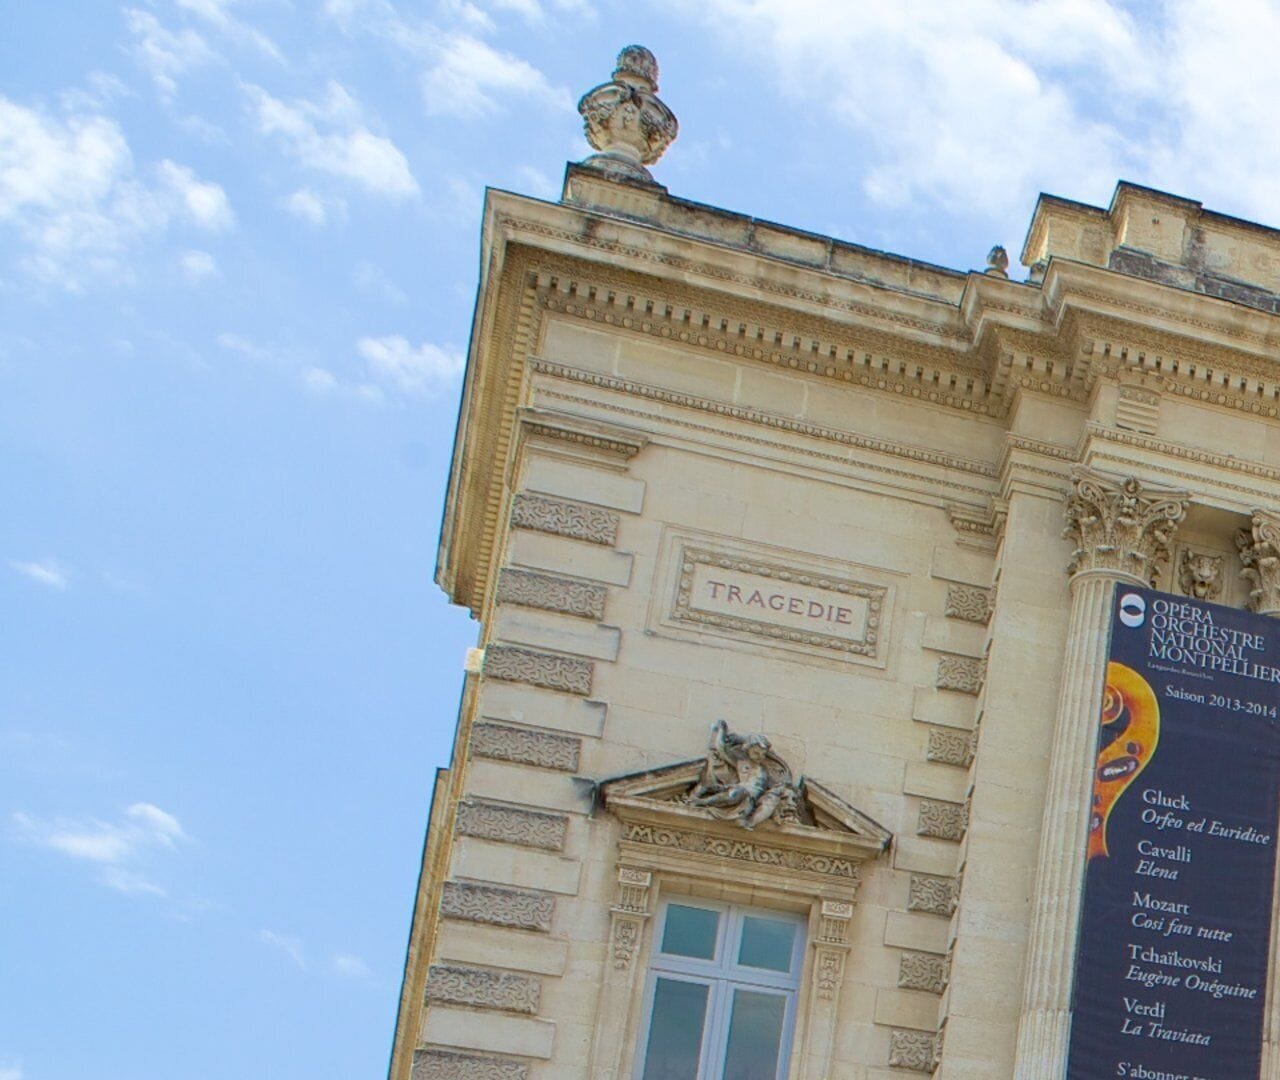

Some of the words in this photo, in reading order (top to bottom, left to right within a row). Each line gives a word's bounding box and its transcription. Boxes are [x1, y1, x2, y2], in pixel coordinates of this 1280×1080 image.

[707, 580, 853, 624] TRAGEDIE
[1153, 600, 1214, 625] OPÉRA
[1150, 628, 1249, 661] NATIONAL
[1151, 614, 1265, 651] ORCHESTRE
[1165, 685, 1205, 704] Saison
[1209, 694, 1278, 719] 2013-2014
[1142, 789, 1191, 810] Gluck
[1141, 809, 1183, 831] Orfeo
[1187, 819, 1206, 833] ed
[1208, 823, 1271, 845] Euridice
[1137, 840, 1192, 863] Cavalli
[1135, 861, 1179, 881] Elena
[1133, 891, 1190, 915] Mozart
[1164, 918, 1193, 936] fan
[1196, 926, 1233, 942] tutte
[1128, 944, 1223, 974] Tchaïkovski
[1125, 965, 1181, 987] Eugène
[1185, 974, 1257, 999] Onéguine
[1123, 998, 1166, 1018] Verdi
[1120, 1018, 1142, 1036] La
[1149, 1022, 1212, 1046] Traviata
